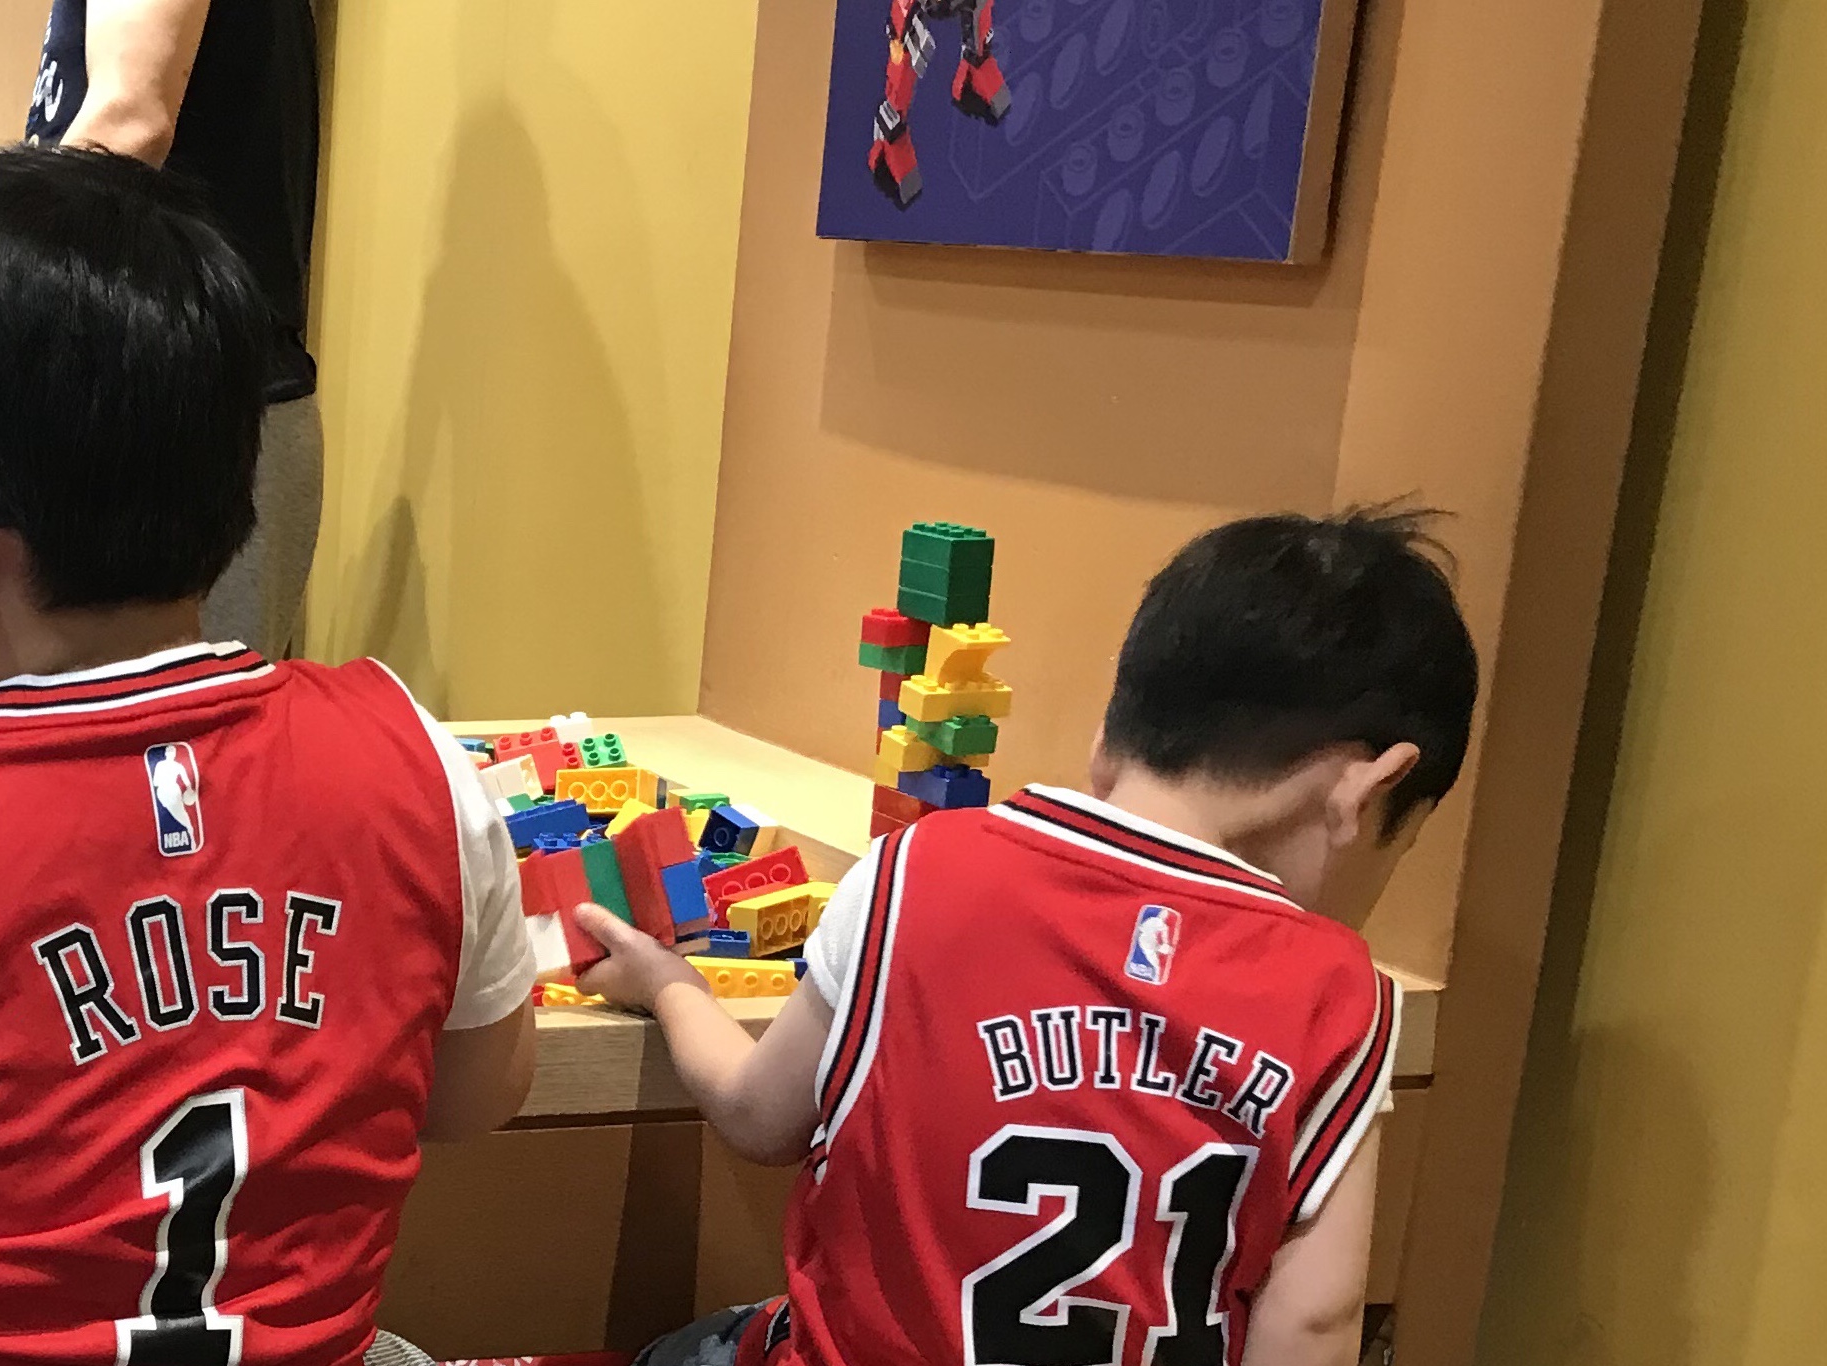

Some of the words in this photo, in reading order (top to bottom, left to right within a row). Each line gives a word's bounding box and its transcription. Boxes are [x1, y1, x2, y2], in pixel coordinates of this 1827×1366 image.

[164, 831, 190, 848] NBA
[31, 888, 342, 1066] ROSE
[976, 1005, 1295, 1139] BUTLER
